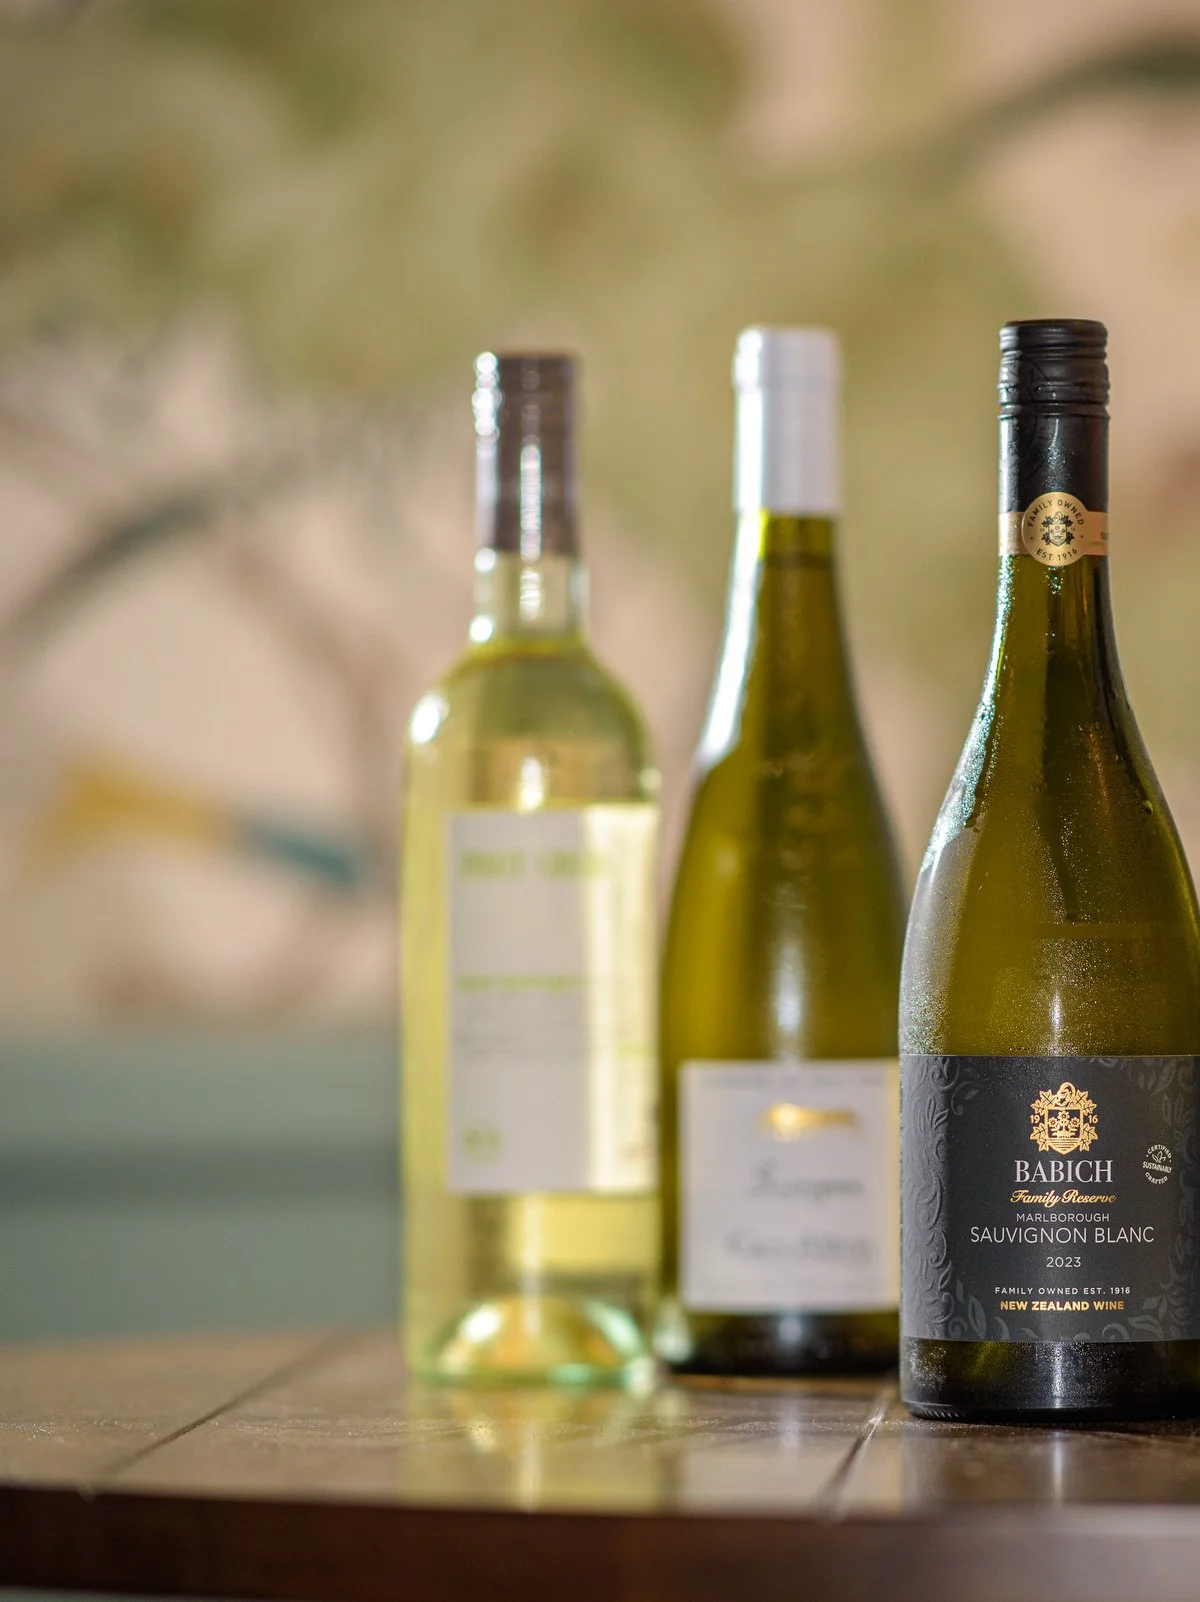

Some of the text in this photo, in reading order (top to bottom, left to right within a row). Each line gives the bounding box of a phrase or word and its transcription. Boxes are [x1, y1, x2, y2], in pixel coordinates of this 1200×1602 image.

[1028, 499, 1085, 527] FAMILY OWNED
[1036, 548, 1078, 561] EST 1916
[1147, 1144, 1172, 1159] CERTIFIED
[1014, 1159, 1113, 1183] BABICH
[1145, 1172, 1168, 1185] CRAFTED
[1010, 1189, 1117, 1208] Family Reserve
[1016, 1213, 1110, 1223] MARLBOROUGH
[970, 1226, 1155, 1244] SAUVIGNON BLANC
[1046, 1256, 1082, 1268] 2023
[995, 1286, 1131, 1295] FAMILY OWNED EST. 1916
[1000, 1300, 1125, 1311] NEW ZEALAND WINE
